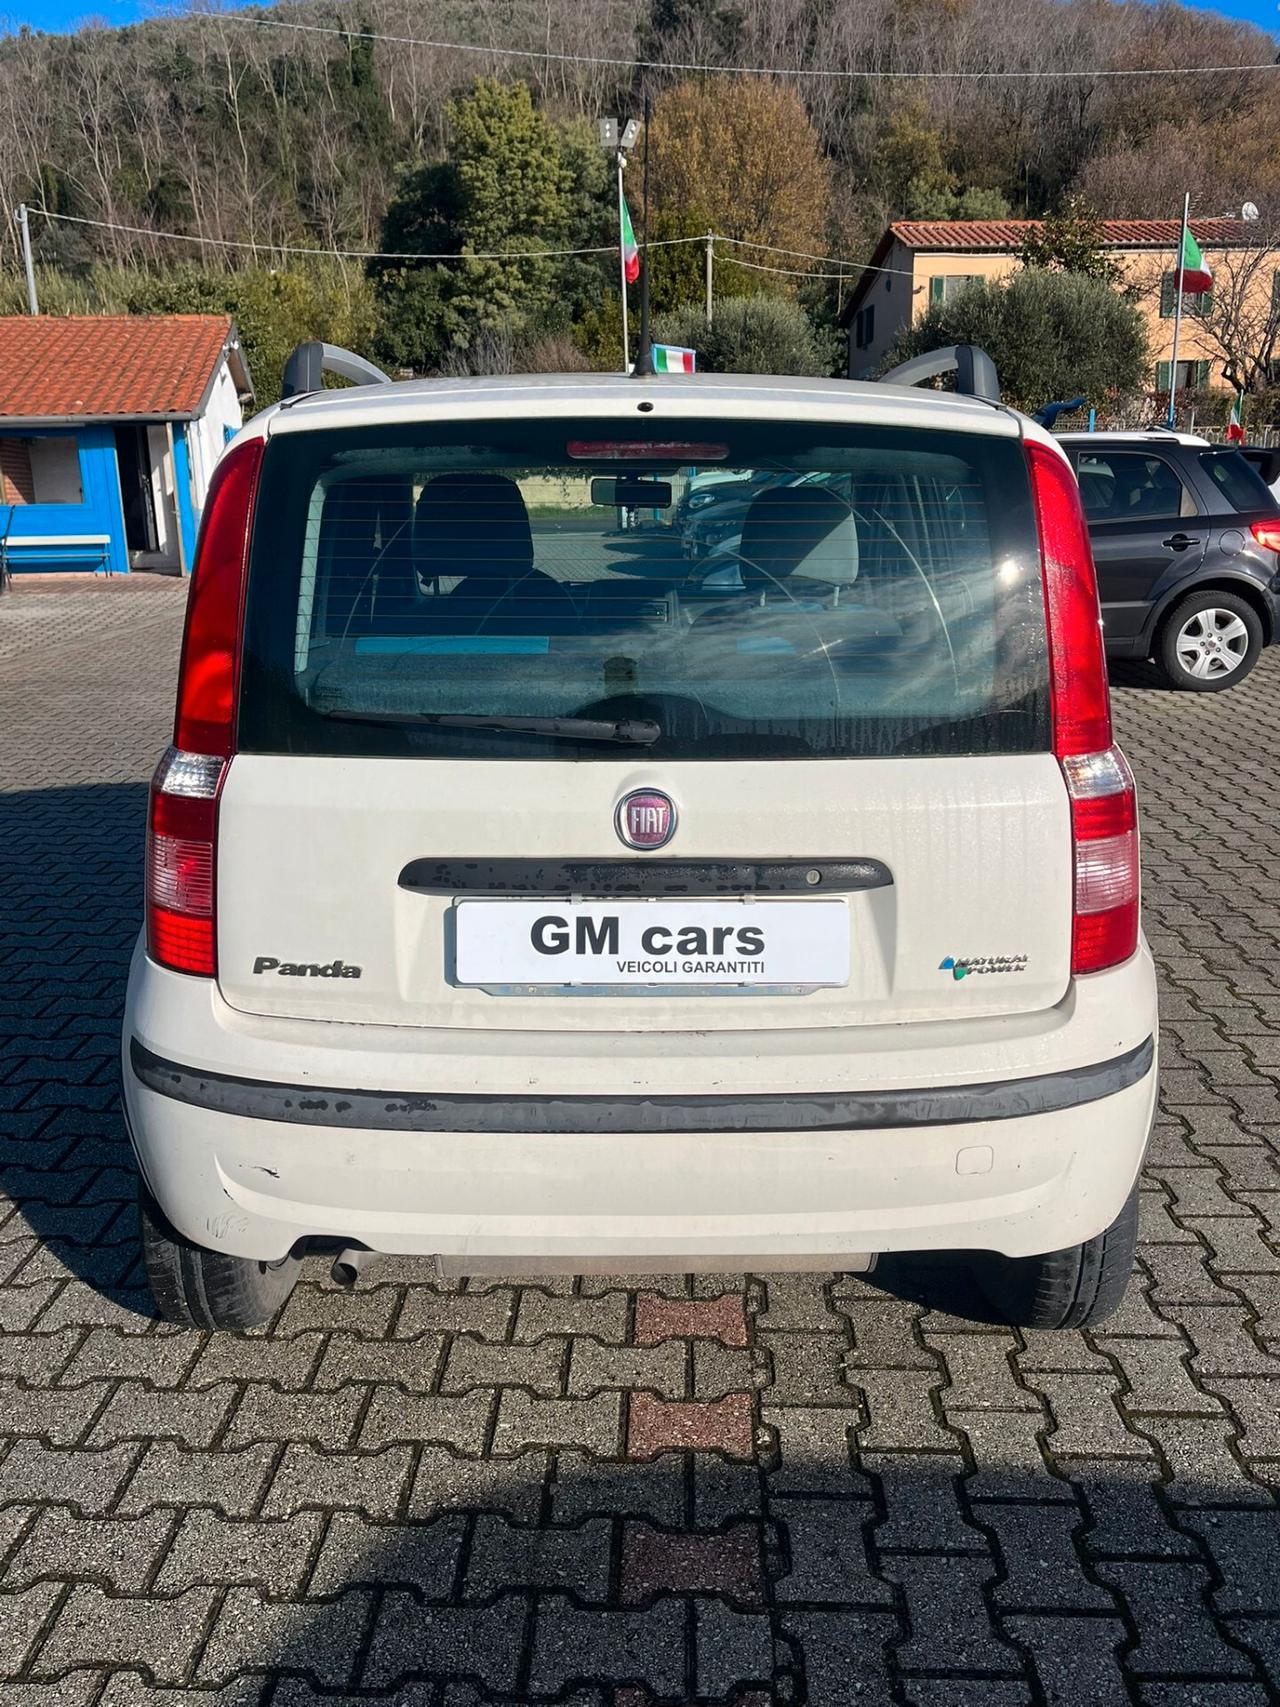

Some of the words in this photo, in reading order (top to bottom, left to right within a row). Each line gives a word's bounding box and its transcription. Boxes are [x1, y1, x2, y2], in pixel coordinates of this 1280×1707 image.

[631, 806, 666, 833] FIAT
[530, 915, 620, 955] GM
[640, 925, 766, 956] cars
[253, 957, 362, 978] Panda
[616, 961, 677, 973] VEICOLI
[682, 960, 765, 973] GARANTITI
